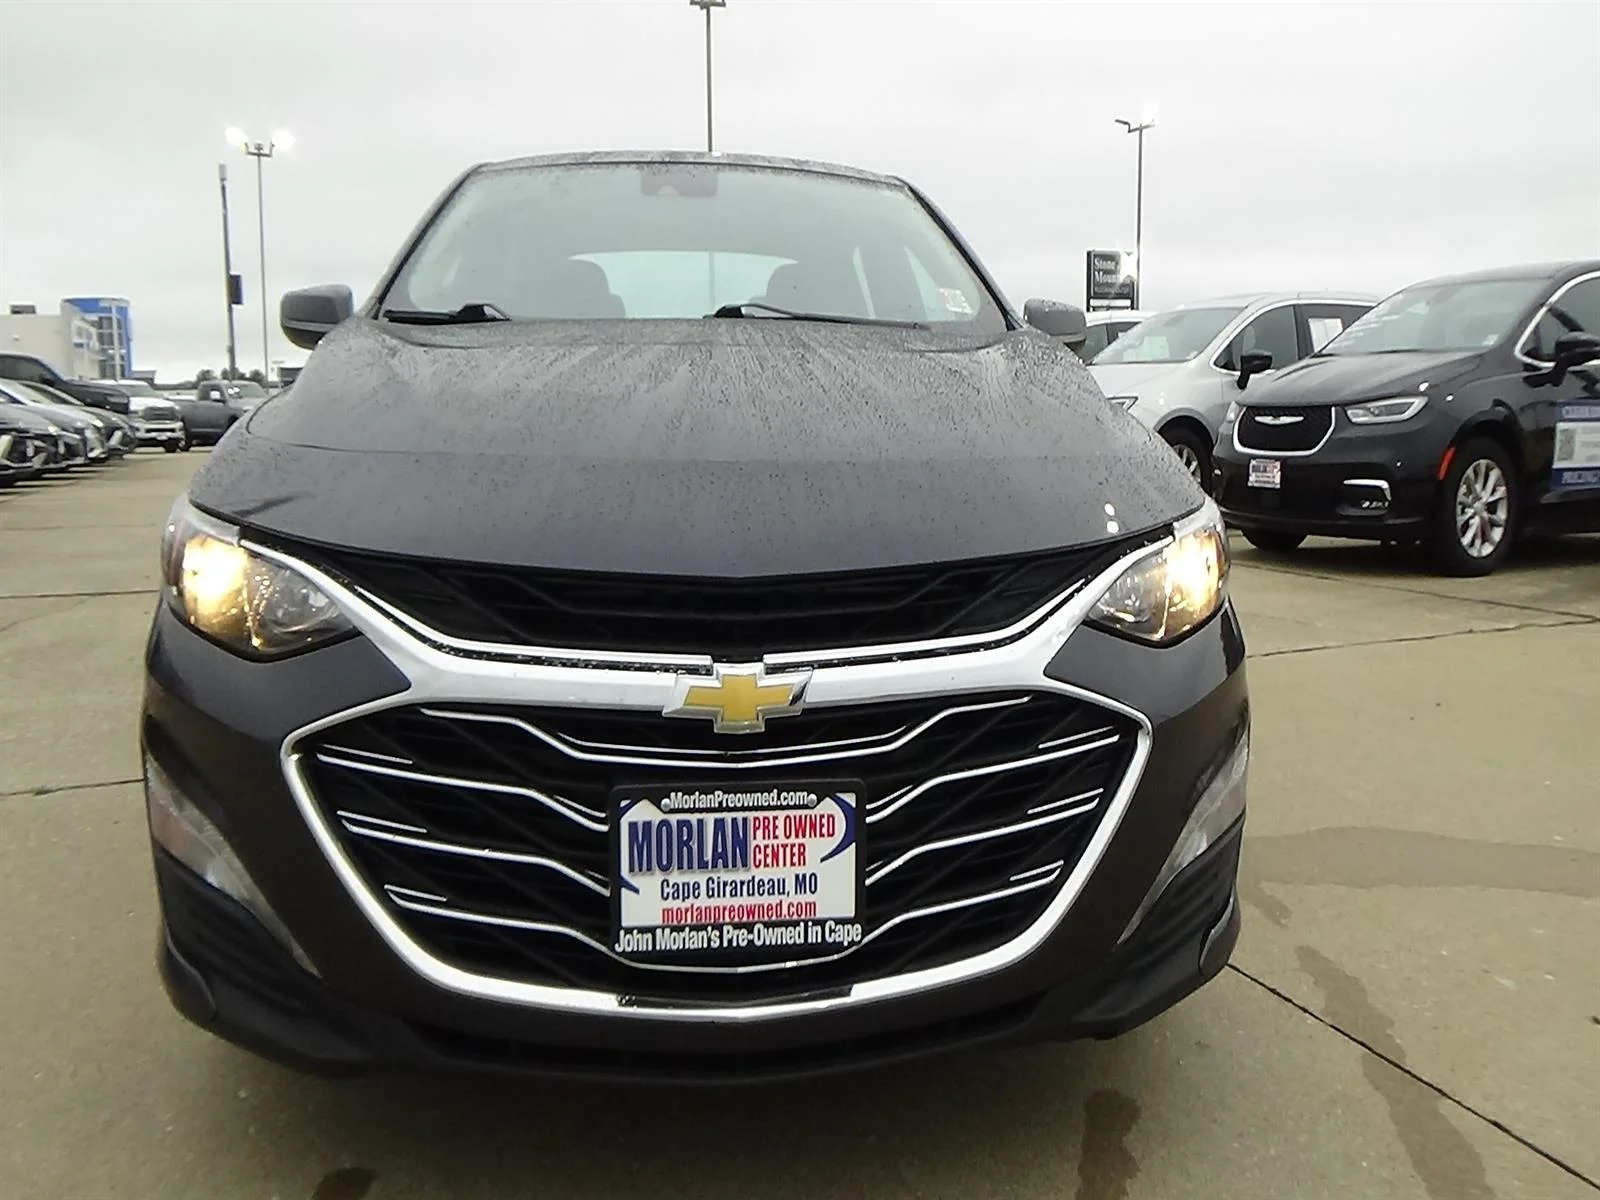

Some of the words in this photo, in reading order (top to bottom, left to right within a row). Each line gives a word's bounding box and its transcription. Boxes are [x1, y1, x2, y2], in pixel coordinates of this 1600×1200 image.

[670, 789, 808, 809] MorlanPreowned.com
[753, 817, 779, 840] PRE
[784, 814, 836, 839] OWNED
[628, 816, 749, 873] MORLAN
[753, 844, 806, 868] CENTER
[661, 878, 701, 903] Cape
[706, 874, 790, 899] Girardeau,
[794, 873, 818, 895] MO
[662, 900, 817, 926] morlanpreowned.com
[615, 929, 653, 953] John
[656, 926, 720, 949] Morlan's
[723, 923, 805, 947] Pre-Owned
[807, 921, 822, 943] in
[825, 920, 863, 945] Cape
